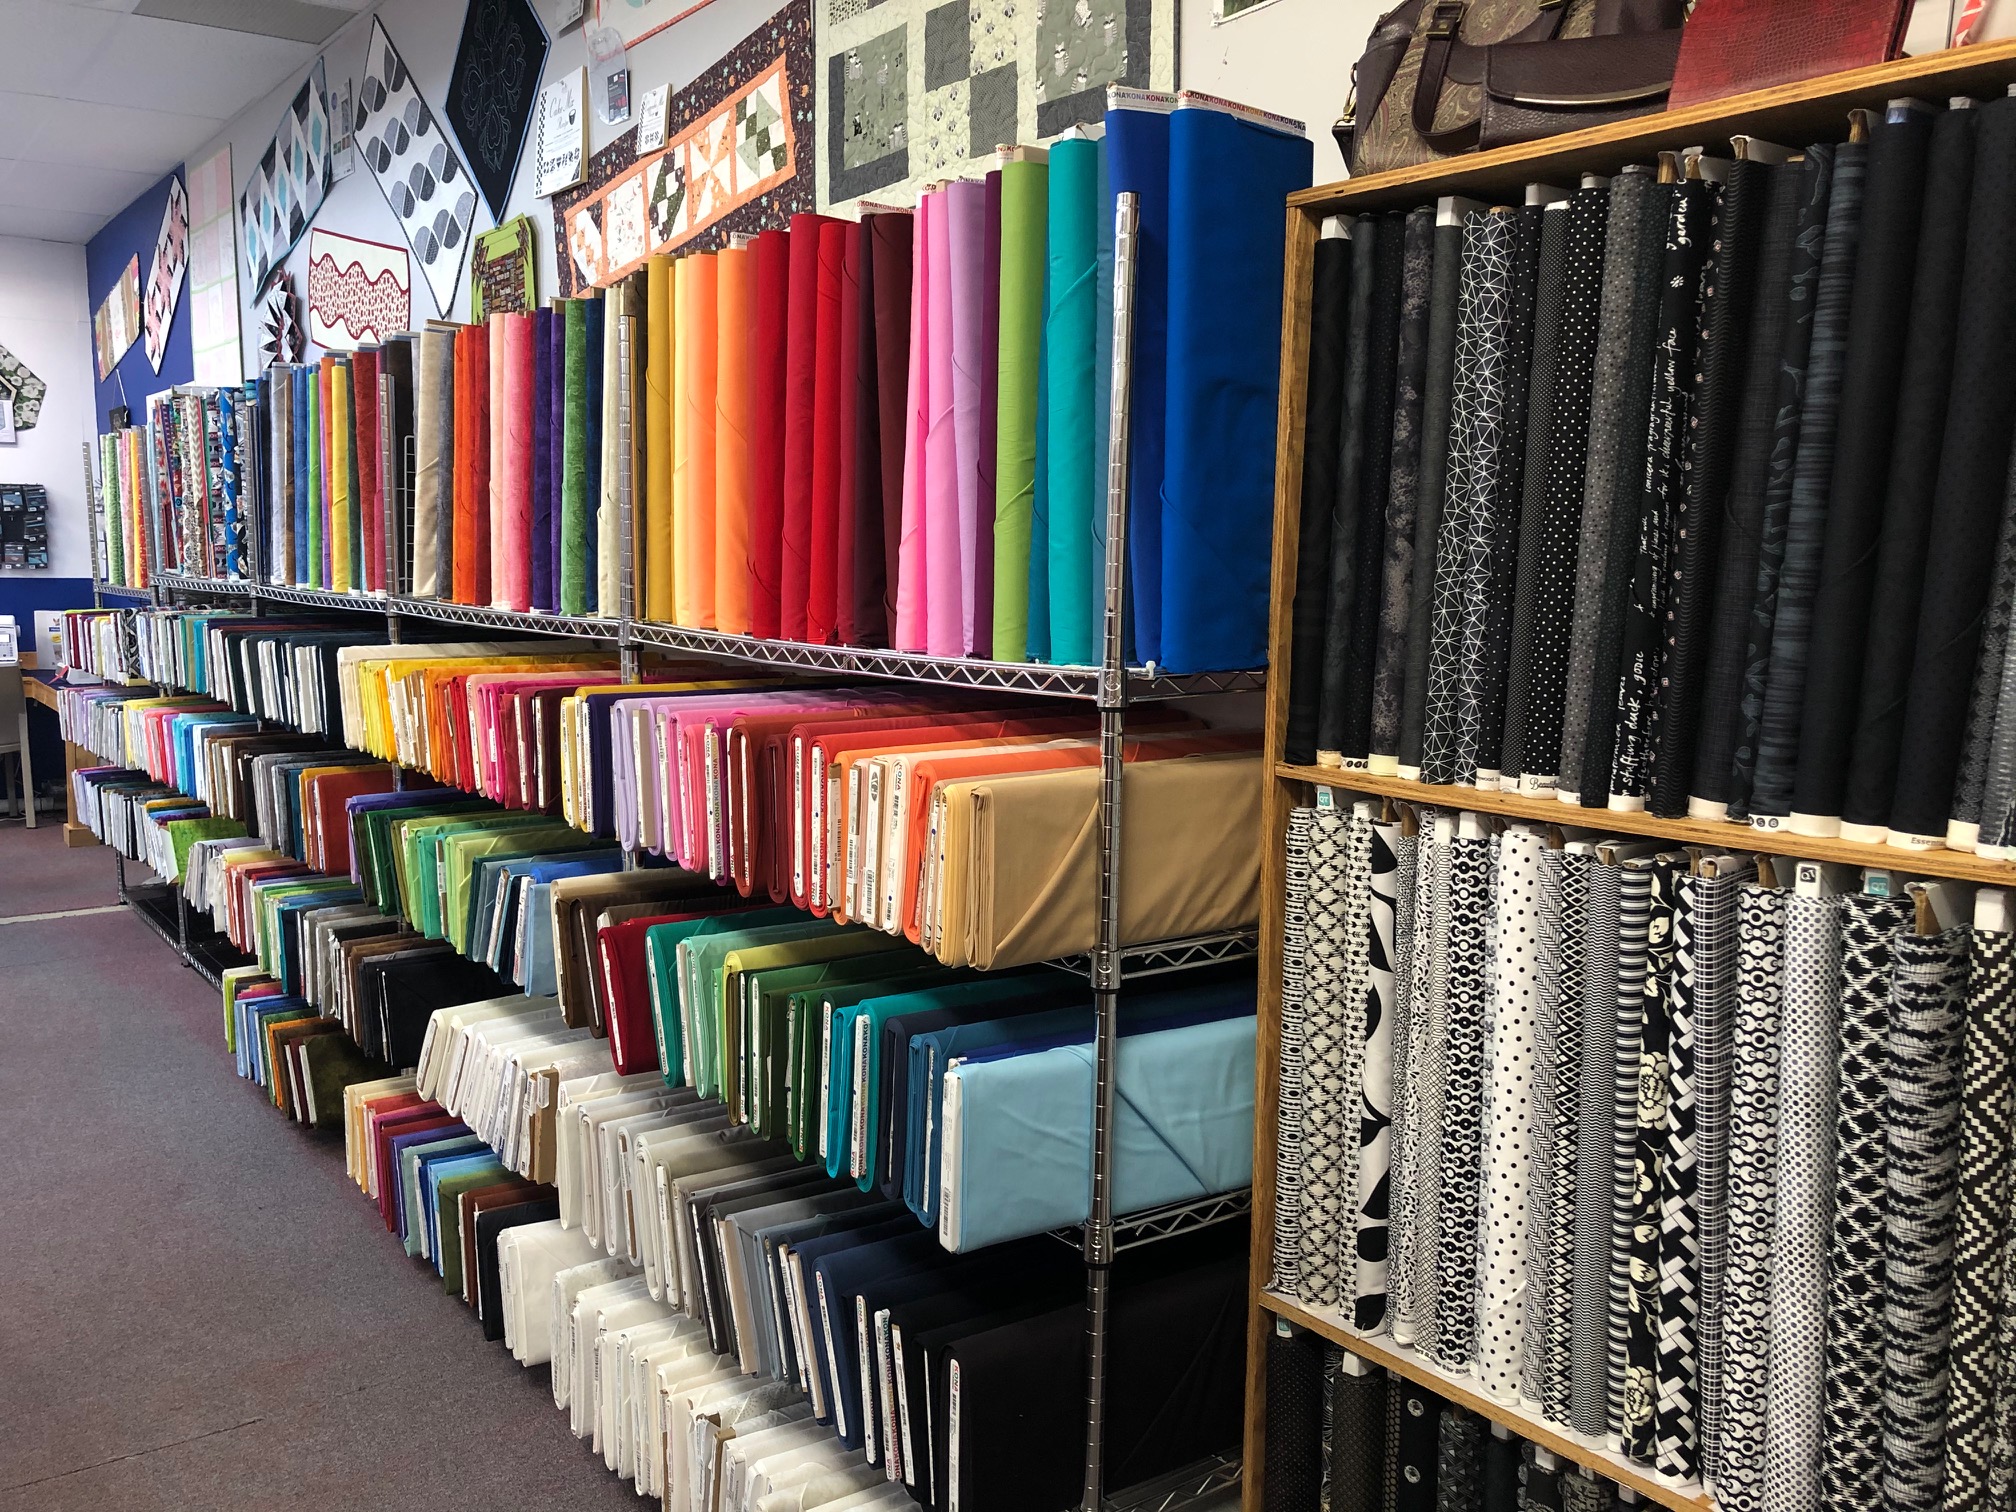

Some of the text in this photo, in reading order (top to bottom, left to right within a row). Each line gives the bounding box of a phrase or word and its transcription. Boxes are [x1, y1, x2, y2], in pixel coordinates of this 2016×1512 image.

[1662, 327, 1681, 357] face
[1664, 359, 1682, 397] yellow
[1619, 735, 1642, 787] stuffing
